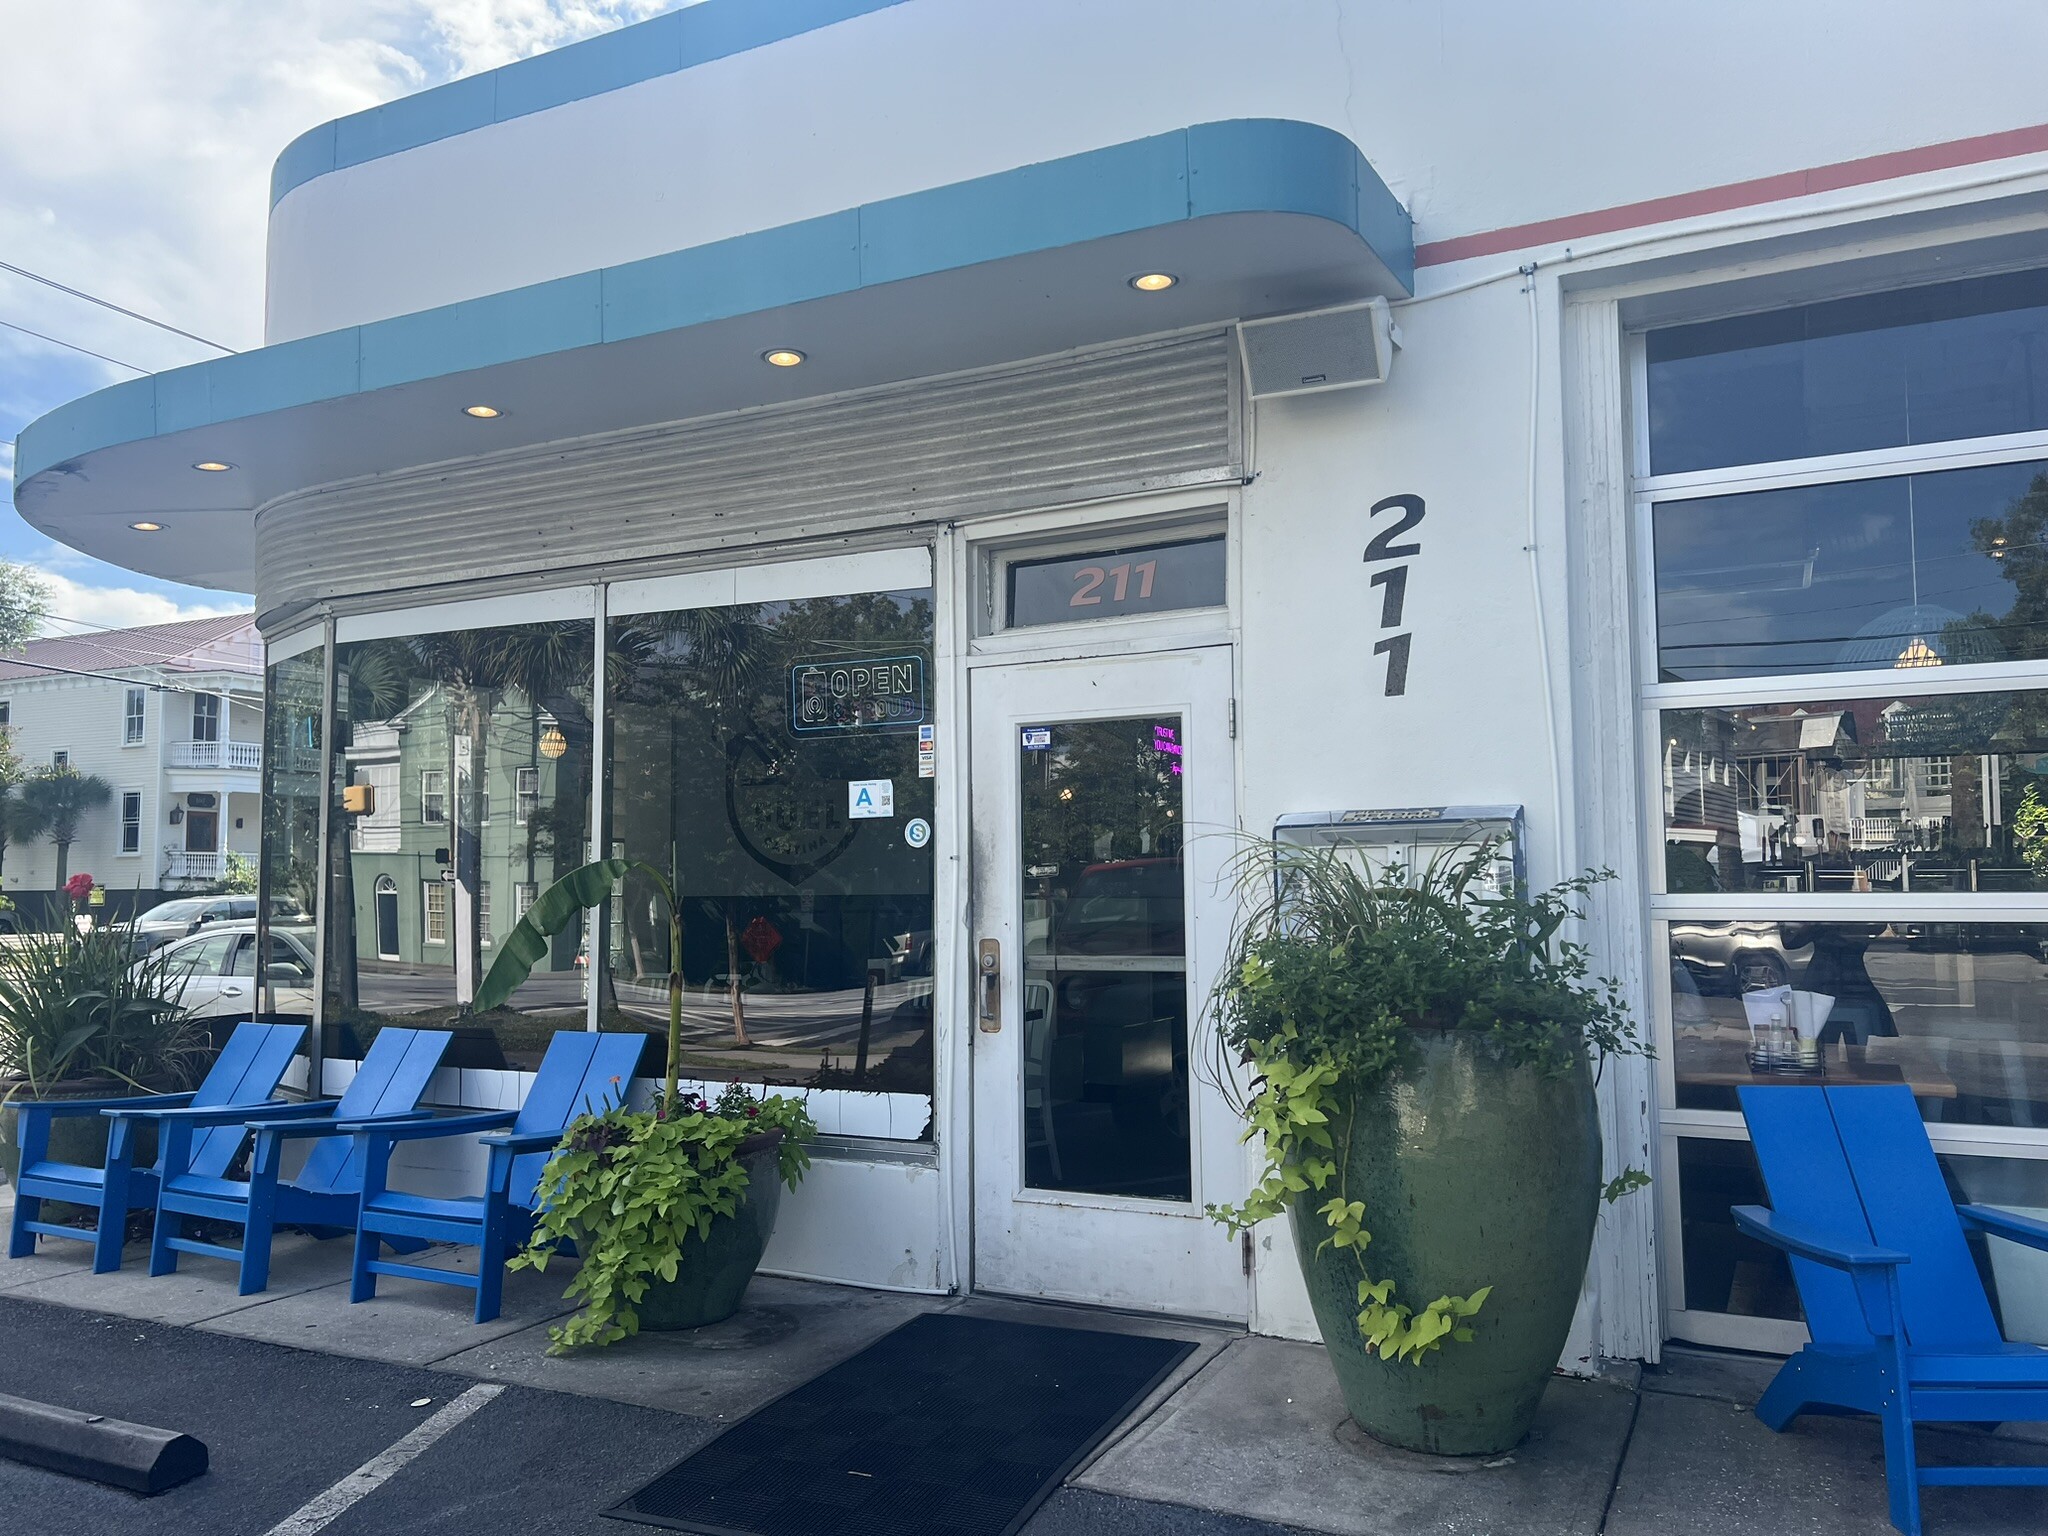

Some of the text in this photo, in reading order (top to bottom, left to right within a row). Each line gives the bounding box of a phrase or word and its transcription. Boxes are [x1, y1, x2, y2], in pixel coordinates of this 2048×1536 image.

[1069, 559, 1157, 607] 211
[1363, 493, 1426, 697] 211
[830, 664, 913, 698] OPEN
[855, 787, 873, 806] A
